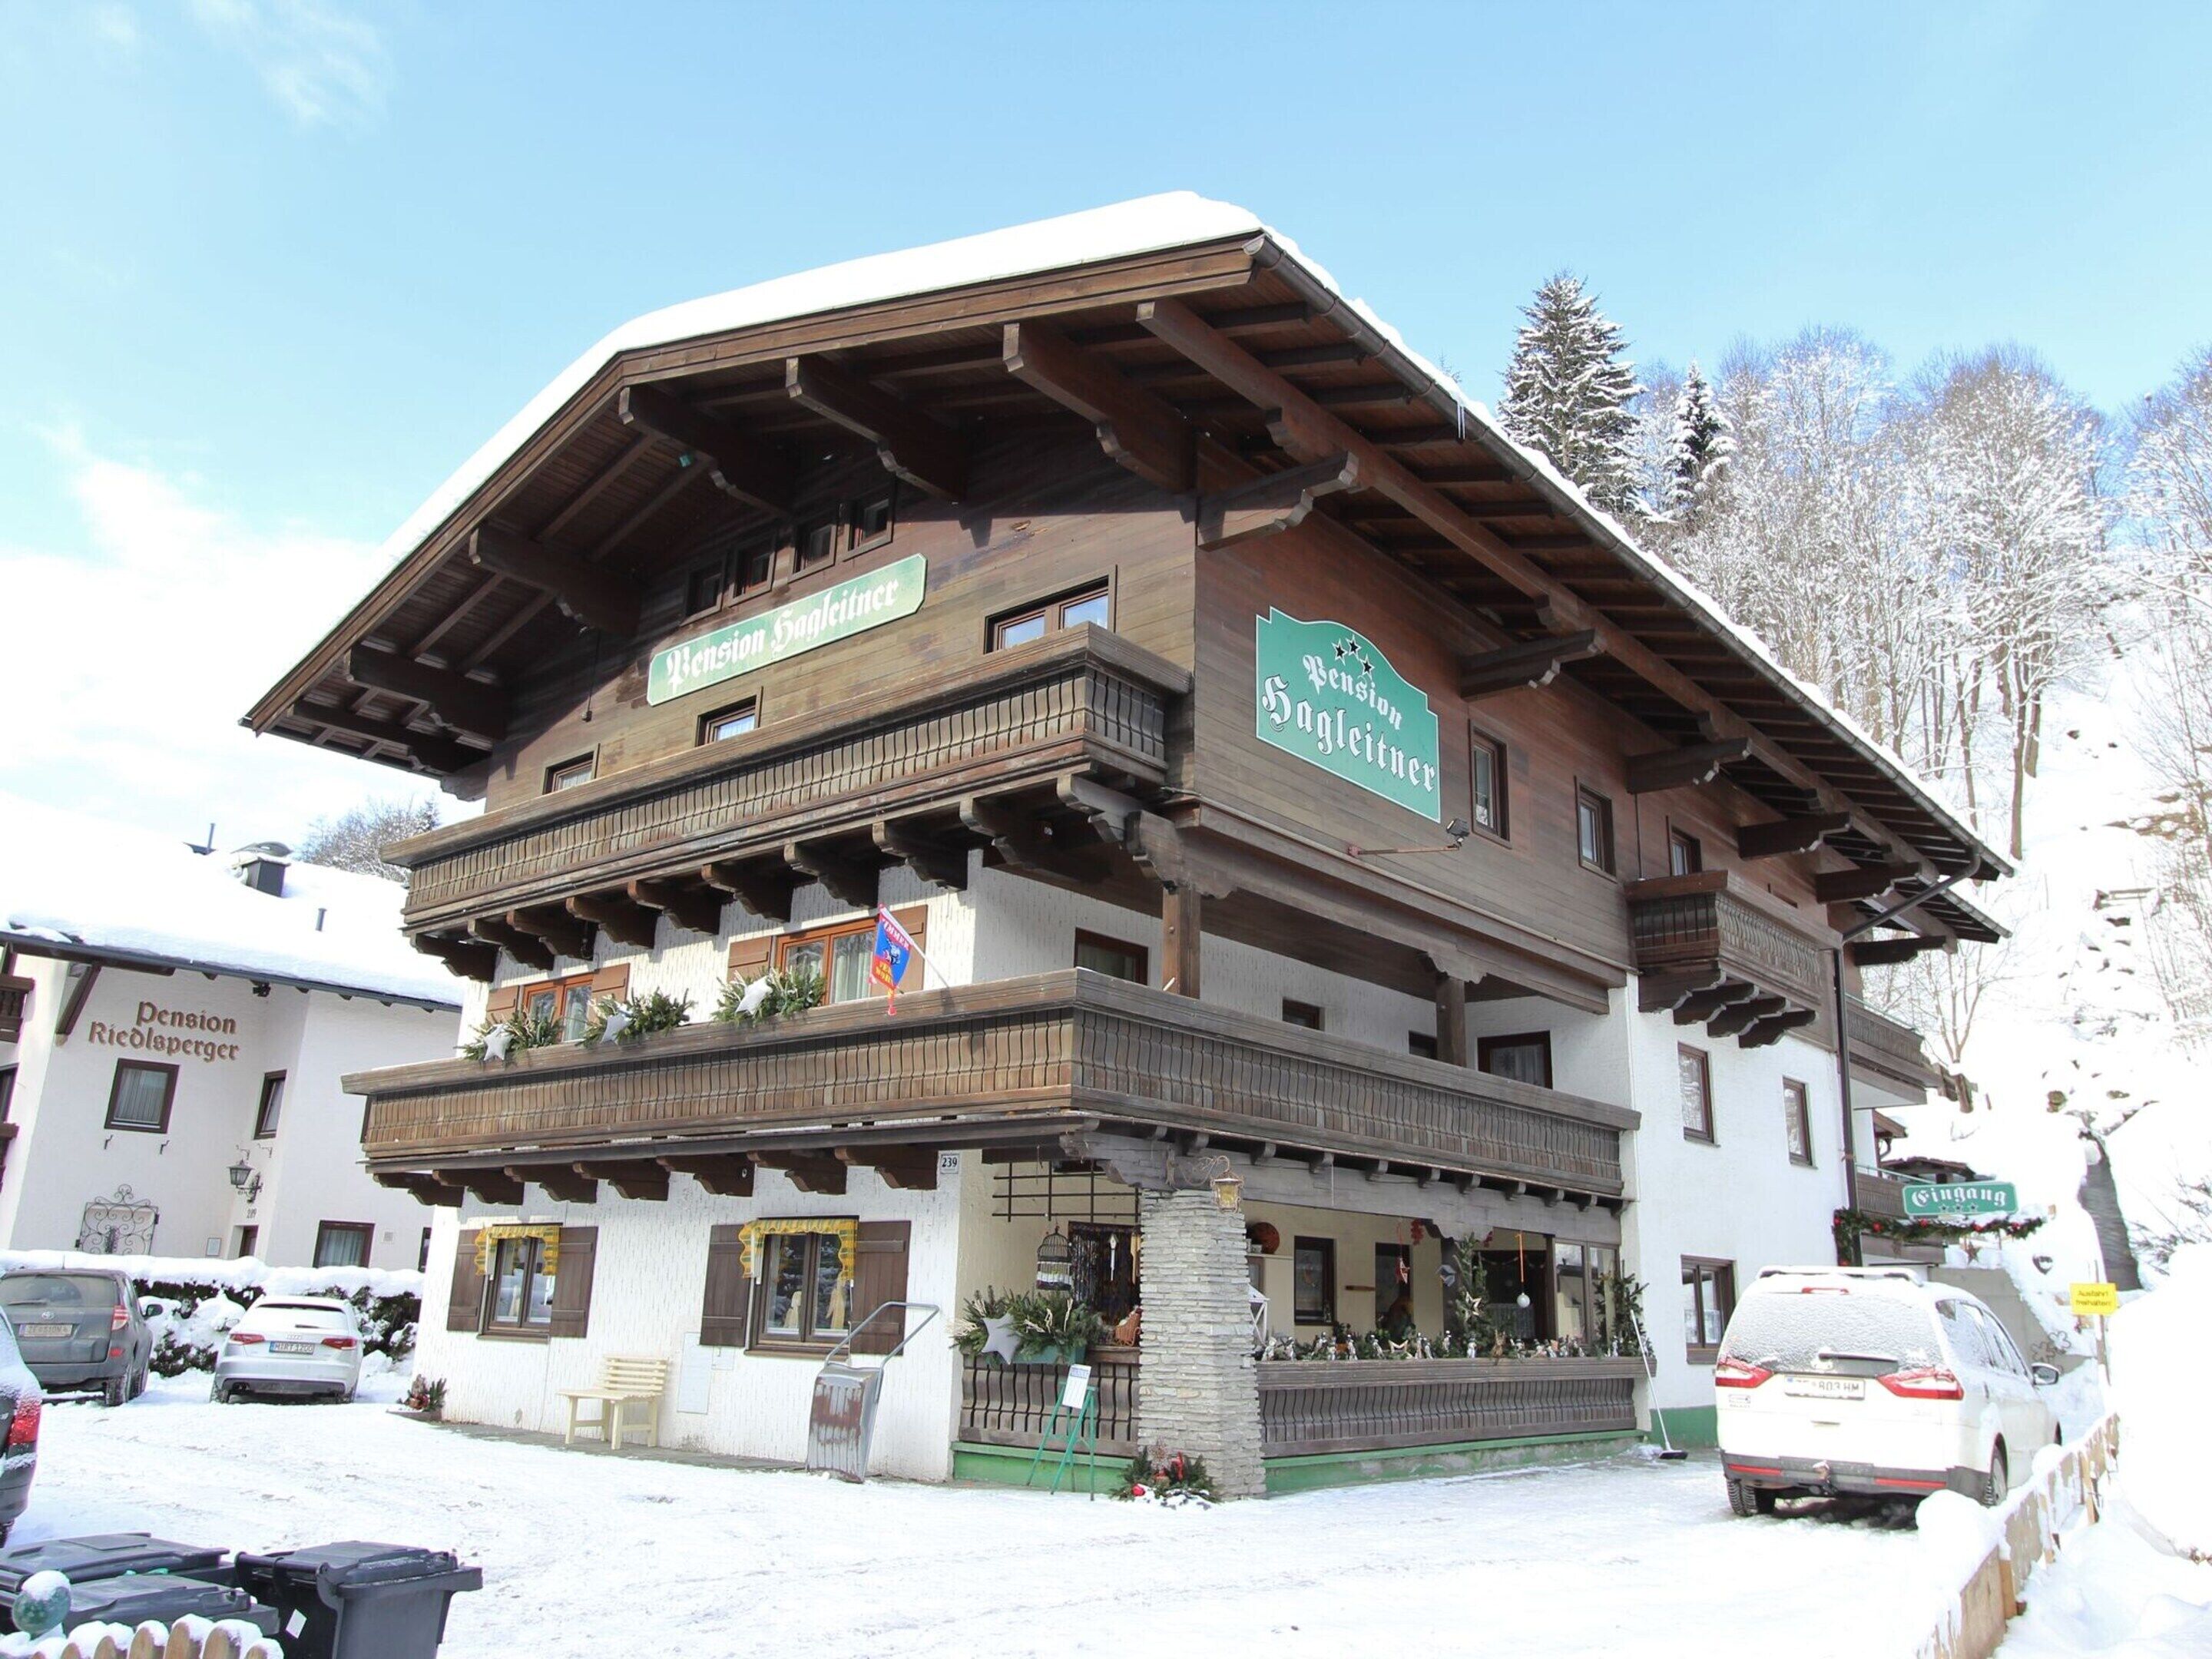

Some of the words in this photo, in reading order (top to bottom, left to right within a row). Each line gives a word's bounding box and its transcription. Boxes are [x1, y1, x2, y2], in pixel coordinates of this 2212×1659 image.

[666, 627, 767, 696] Pension
[770, 578, 899, 654] Hagleitner
[1303, 654, 1402, 730] Pension
[1262, 674, 1435, 792] Hagleitner
[136, 1001, 237, 1035] Pension
[88, 1021, 240, 1063] Riedlsperger
[942, 1157, 958, 1167] 239
[1912, 1187, 2006, 1207] Eingang
